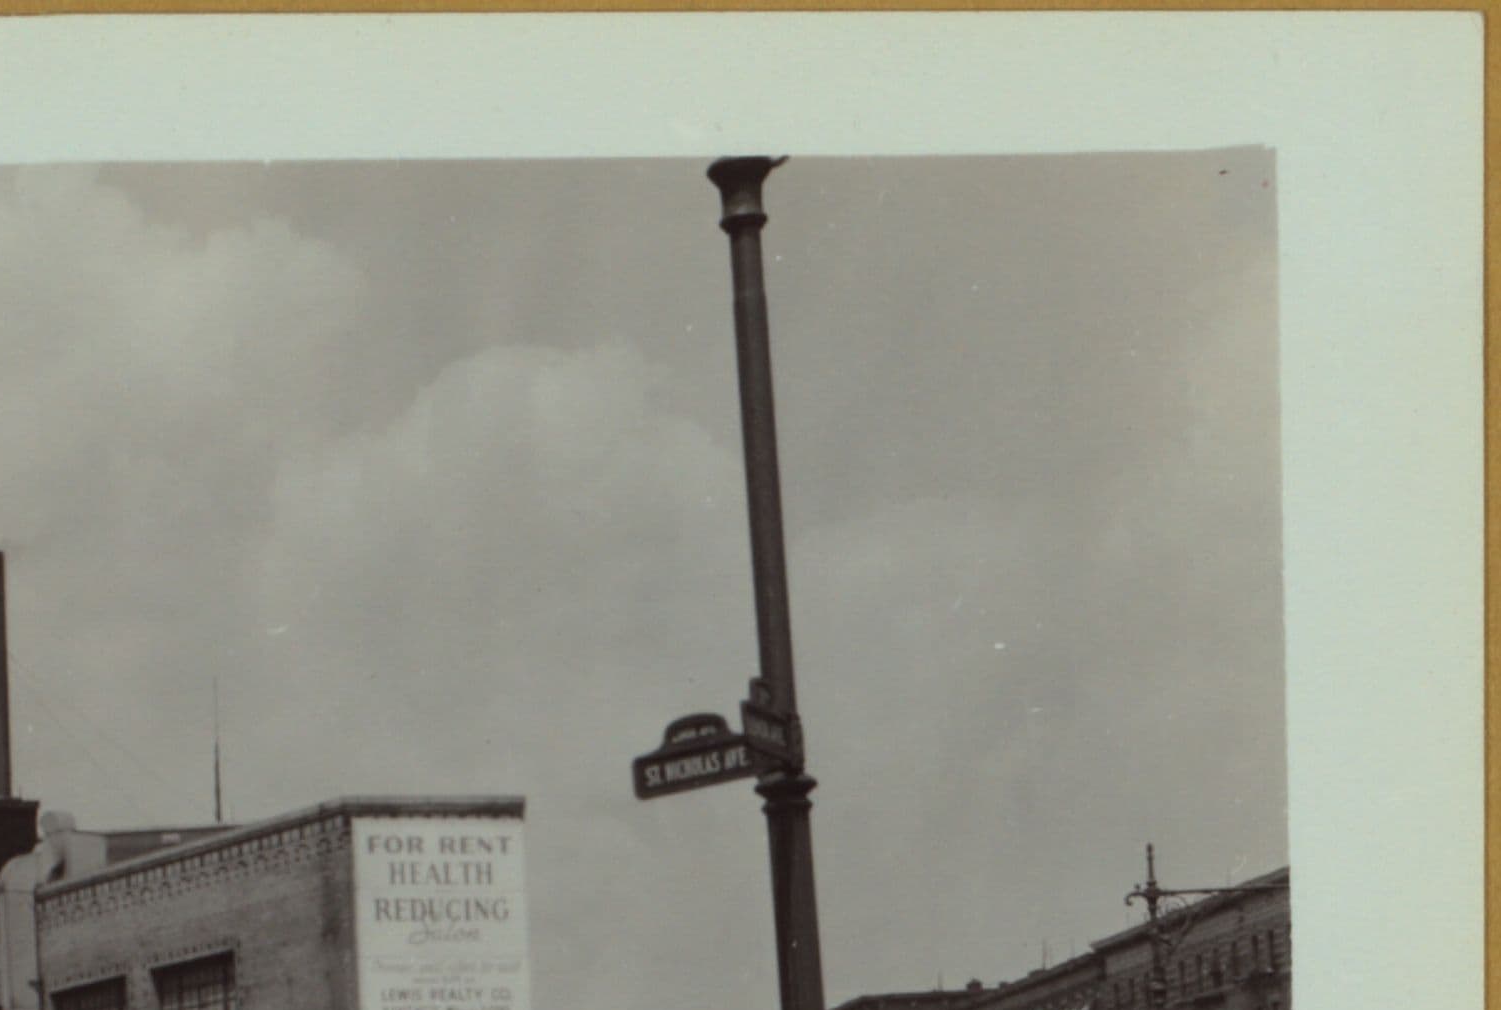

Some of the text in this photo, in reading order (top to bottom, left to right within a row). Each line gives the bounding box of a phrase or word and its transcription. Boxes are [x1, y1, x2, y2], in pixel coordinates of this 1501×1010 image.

[664, 751, 721, 783] NICHOLAS
[367, 835, 512, 855] FOR RENT
[388, 861, 494, 886] HEALTH
[373, 897, 510, 922] REDUCING
[380, 986, 422, 1001] LEWIS
[429, 986, 484, 1001] REALTY
